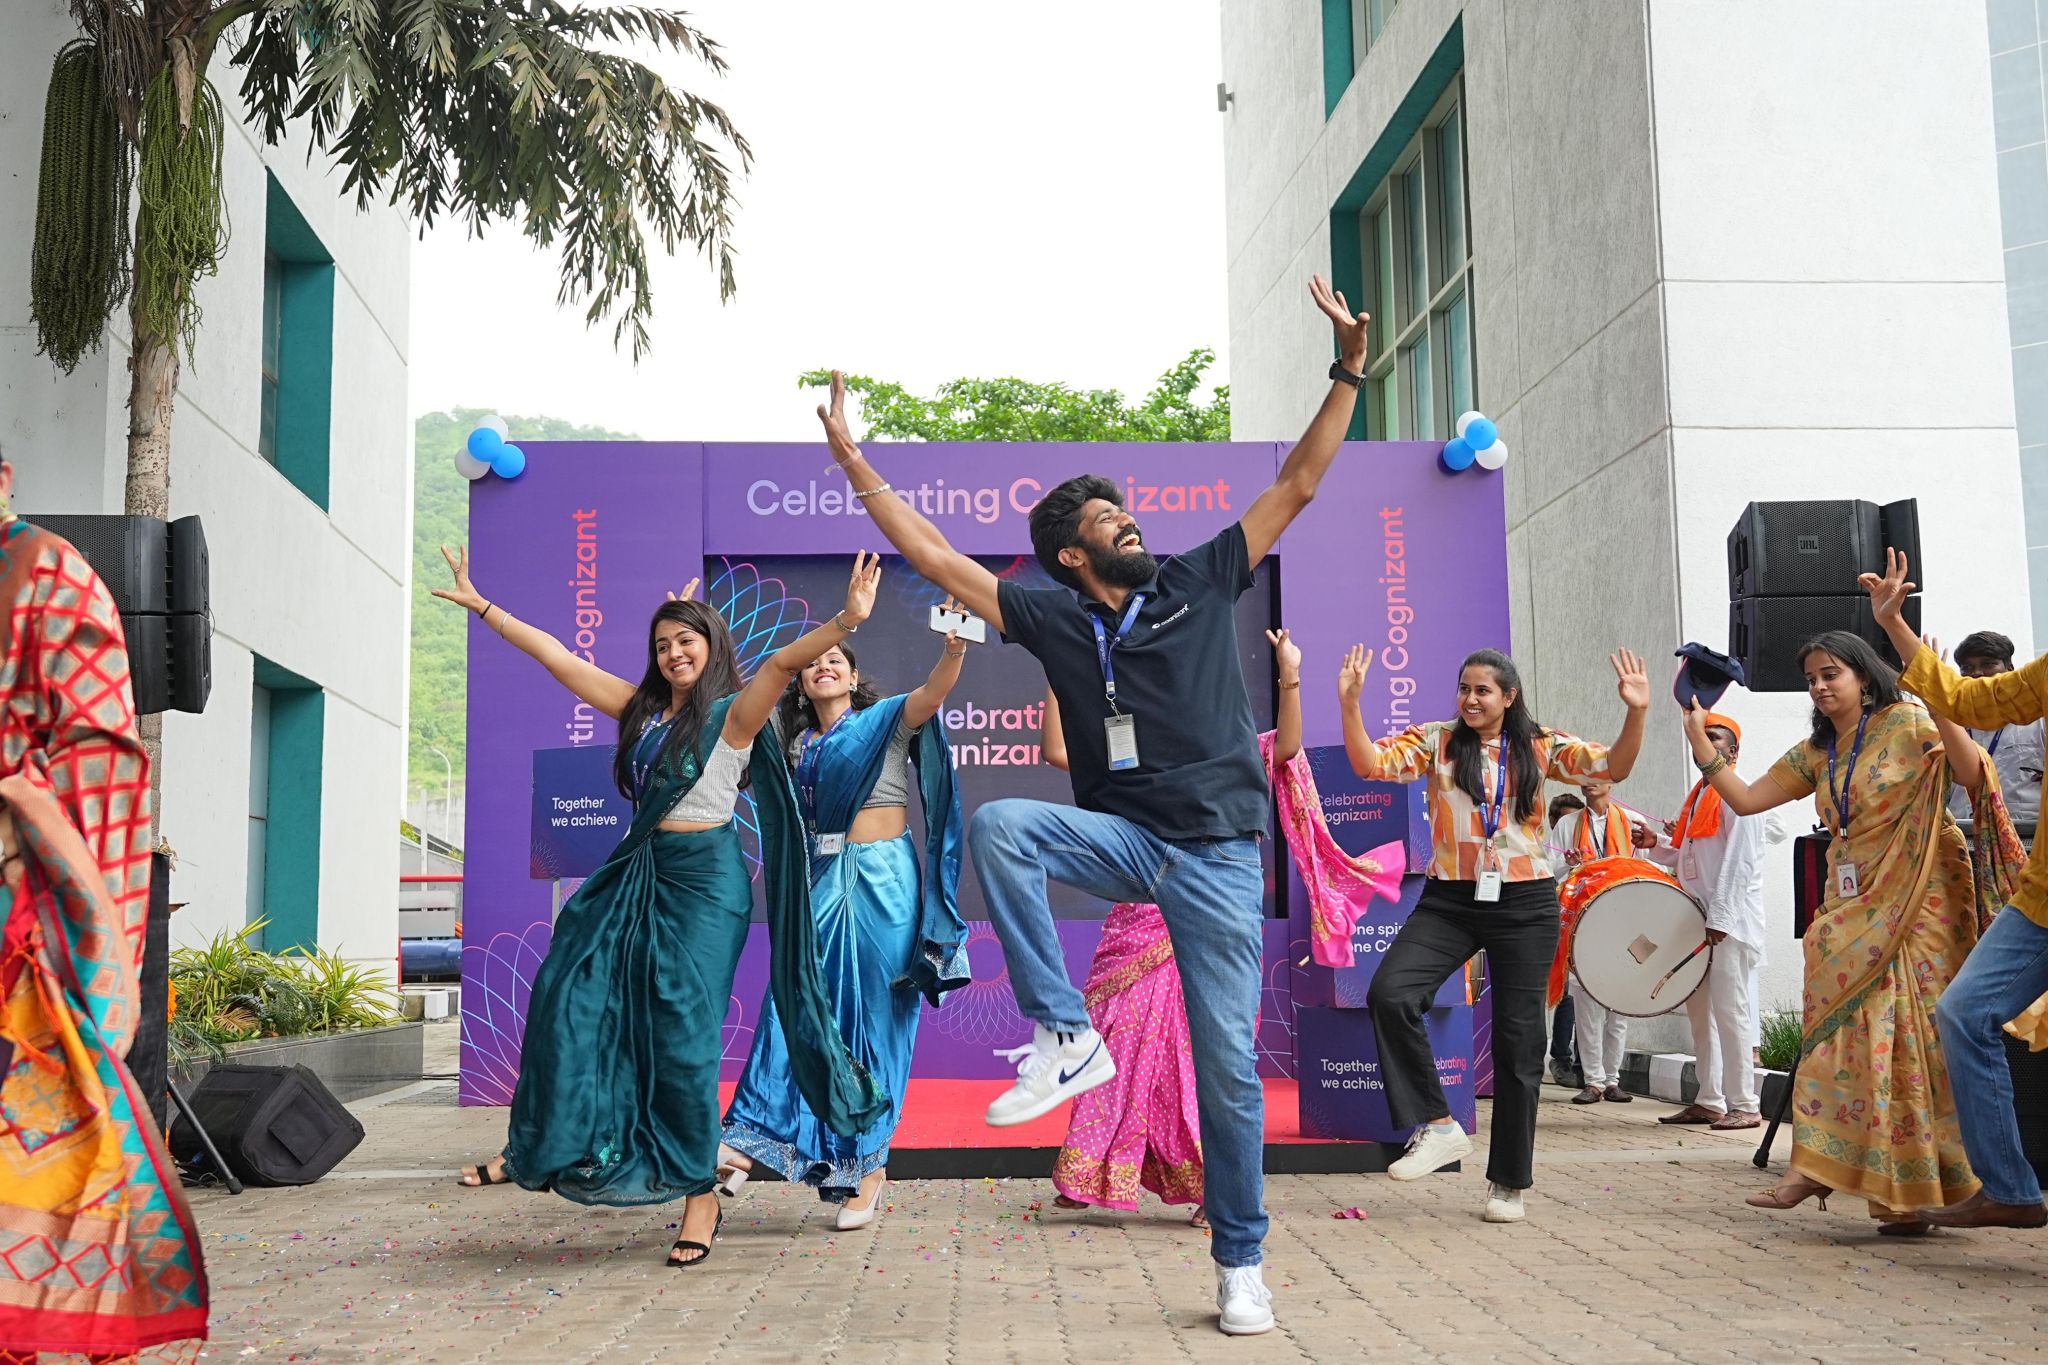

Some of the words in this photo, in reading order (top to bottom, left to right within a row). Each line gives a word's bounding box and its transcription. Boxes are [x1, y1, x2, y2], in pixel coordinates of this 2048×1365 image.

[1008, 476, 1231, 513] Cizant
[1800, 541, 1817, 550] JBL
[1379, 507, 1414, 671] Cognizant
[551, 796, 605, 812] Together
[551, 817, 568, 827] we
[571, 813, 618, 826] achieve
[1324, 808, 1383, 825] ognizant
[1357, 925, 1375, 935] ne
[1354, 943, 1372, 953] ne
[1320, 1058, 1378, 1075] Together
[1321, 1078, 1340, 1089] we
[1342, 1076, 1384, 1090] achiev
[1439, 1072, 1462, 1086] nizant
